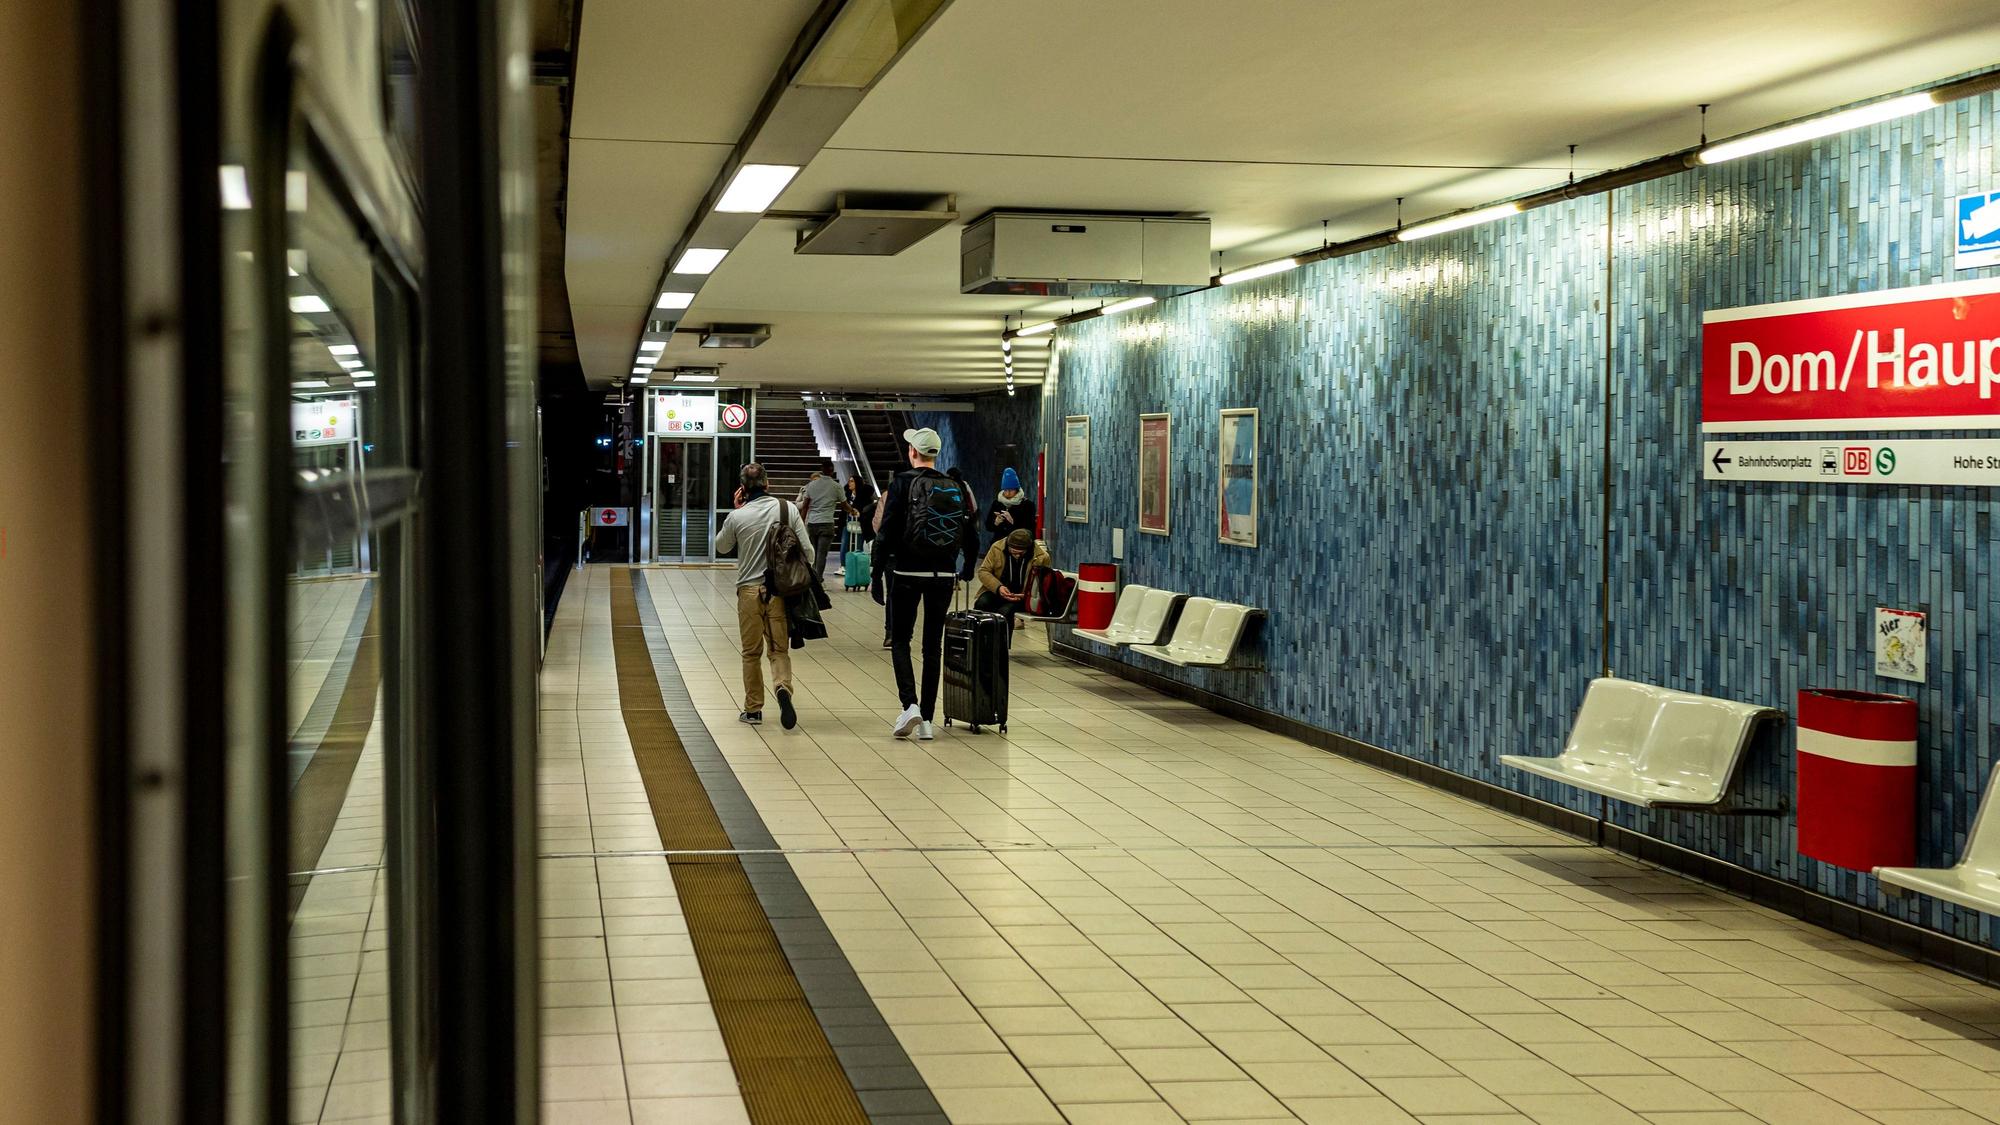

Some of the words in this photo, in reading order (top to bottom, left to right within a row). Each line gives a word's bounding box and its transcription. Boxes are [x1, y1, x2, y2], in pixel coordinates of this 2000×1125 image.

[669, 422, 681, 430] DB
[684, 422, 692, 430] S
[1738, 456, 1812, 470] Bahnhofsvorplatz
[1846, 450, 1869, 472] DB
[1877, 448, 1895, 474] S
[1953, 455, 1984, 469] Hohe
